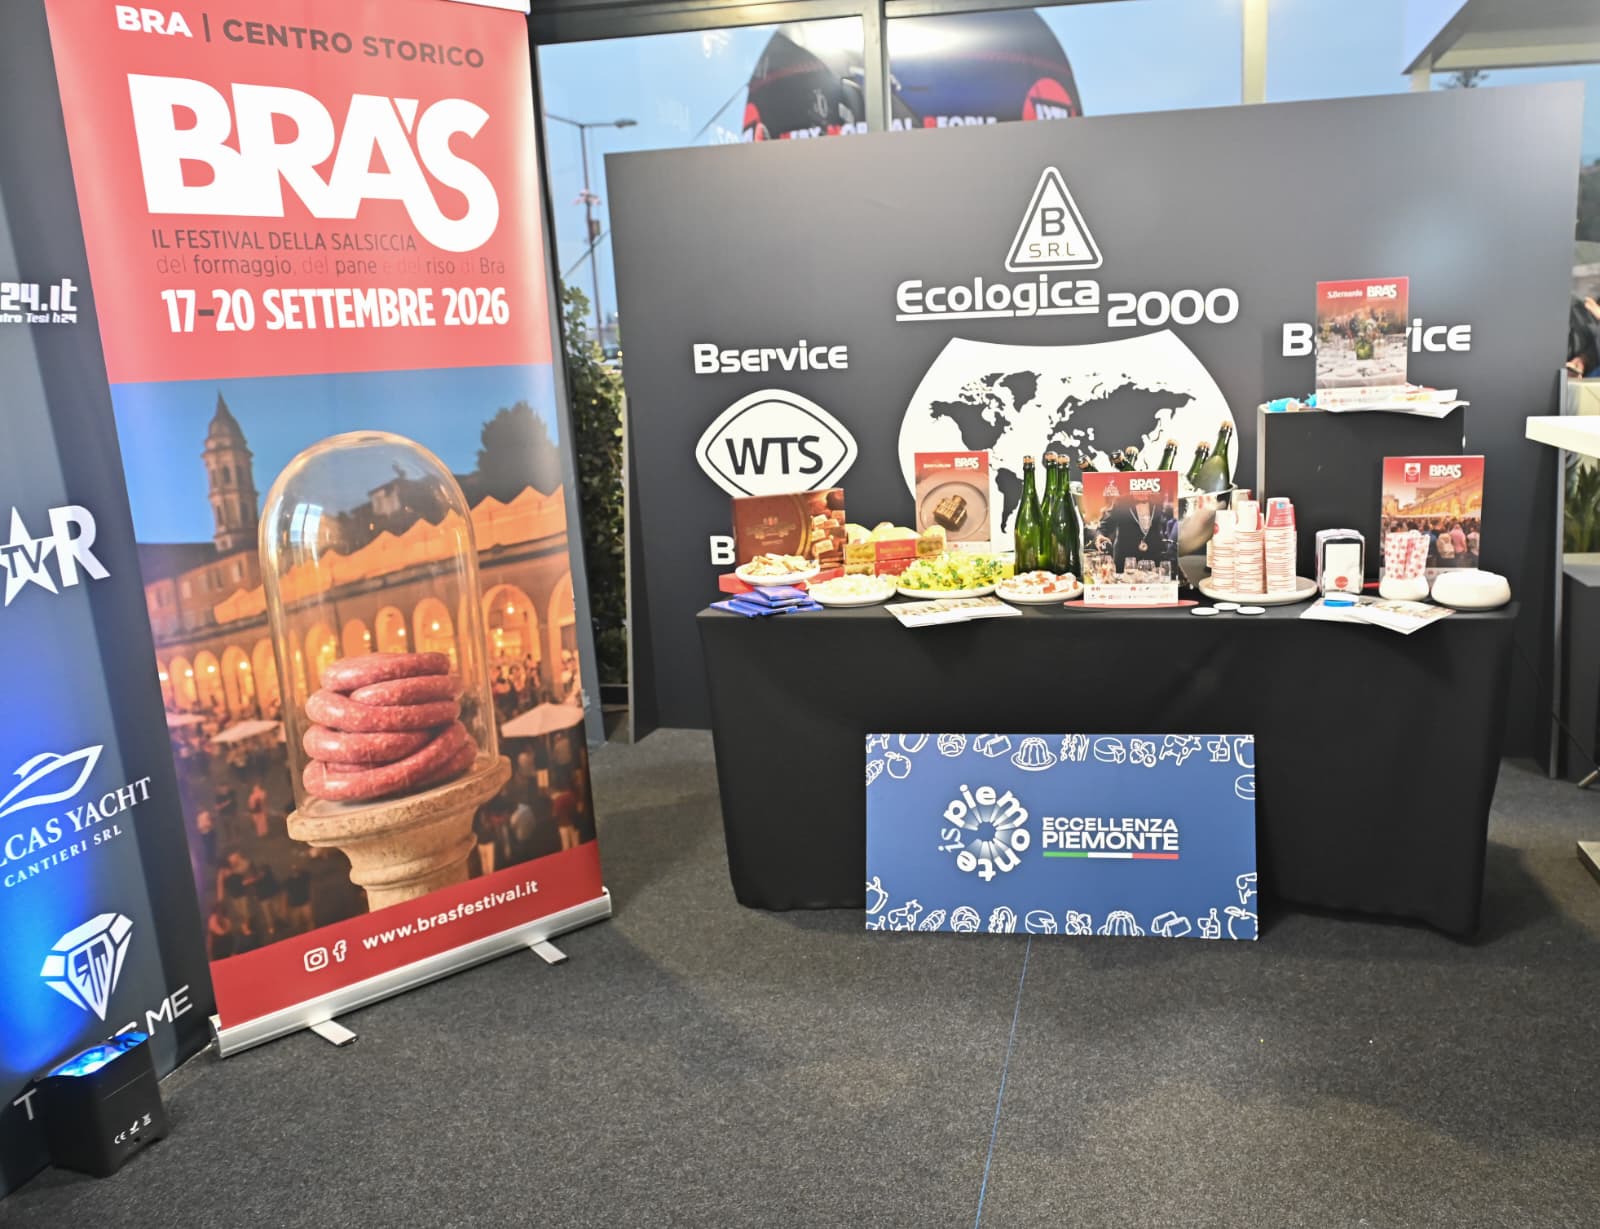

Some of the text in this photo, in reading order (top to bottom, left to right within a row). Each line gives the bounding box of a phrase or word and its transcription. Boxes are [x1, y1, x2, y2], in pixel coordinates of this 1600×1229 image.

[115, 5, 484, 68] BRA CENTRO STORICO
[127, 73, 500, 253] BRA'S
[152, 229, 417, 252] IL FESTIVAL DELLA SALSICCIA
[1041, 206, 1066, 237] B
[156, 255, 187, 275] del
[302, 255, 329, 275] del
[335, 257, 377, 278] pane
[426, 257, 456, 275] riso
[480, 256, 506, 275] Bra
[262, 287, 437, 331] SETTEMBRE
[441, 286, 511, 326] 2026
[896, 273, 1240, 328] Ecologica 2000
[693, 339, 849, 374] Bservice
[725, 435, 824, 475] WTS
[64, 776, 151, 833] YACHT
[1042, 817, 1178, 833] ECCELLENZA
[943, 784, 1031, 882] piemonte
[1042, 832, 1179, 851] PIEMONTE
[4, 824, 122, 888] CANTIERI SRL
[362, 880, 539, 950] www.brasfestival.it
